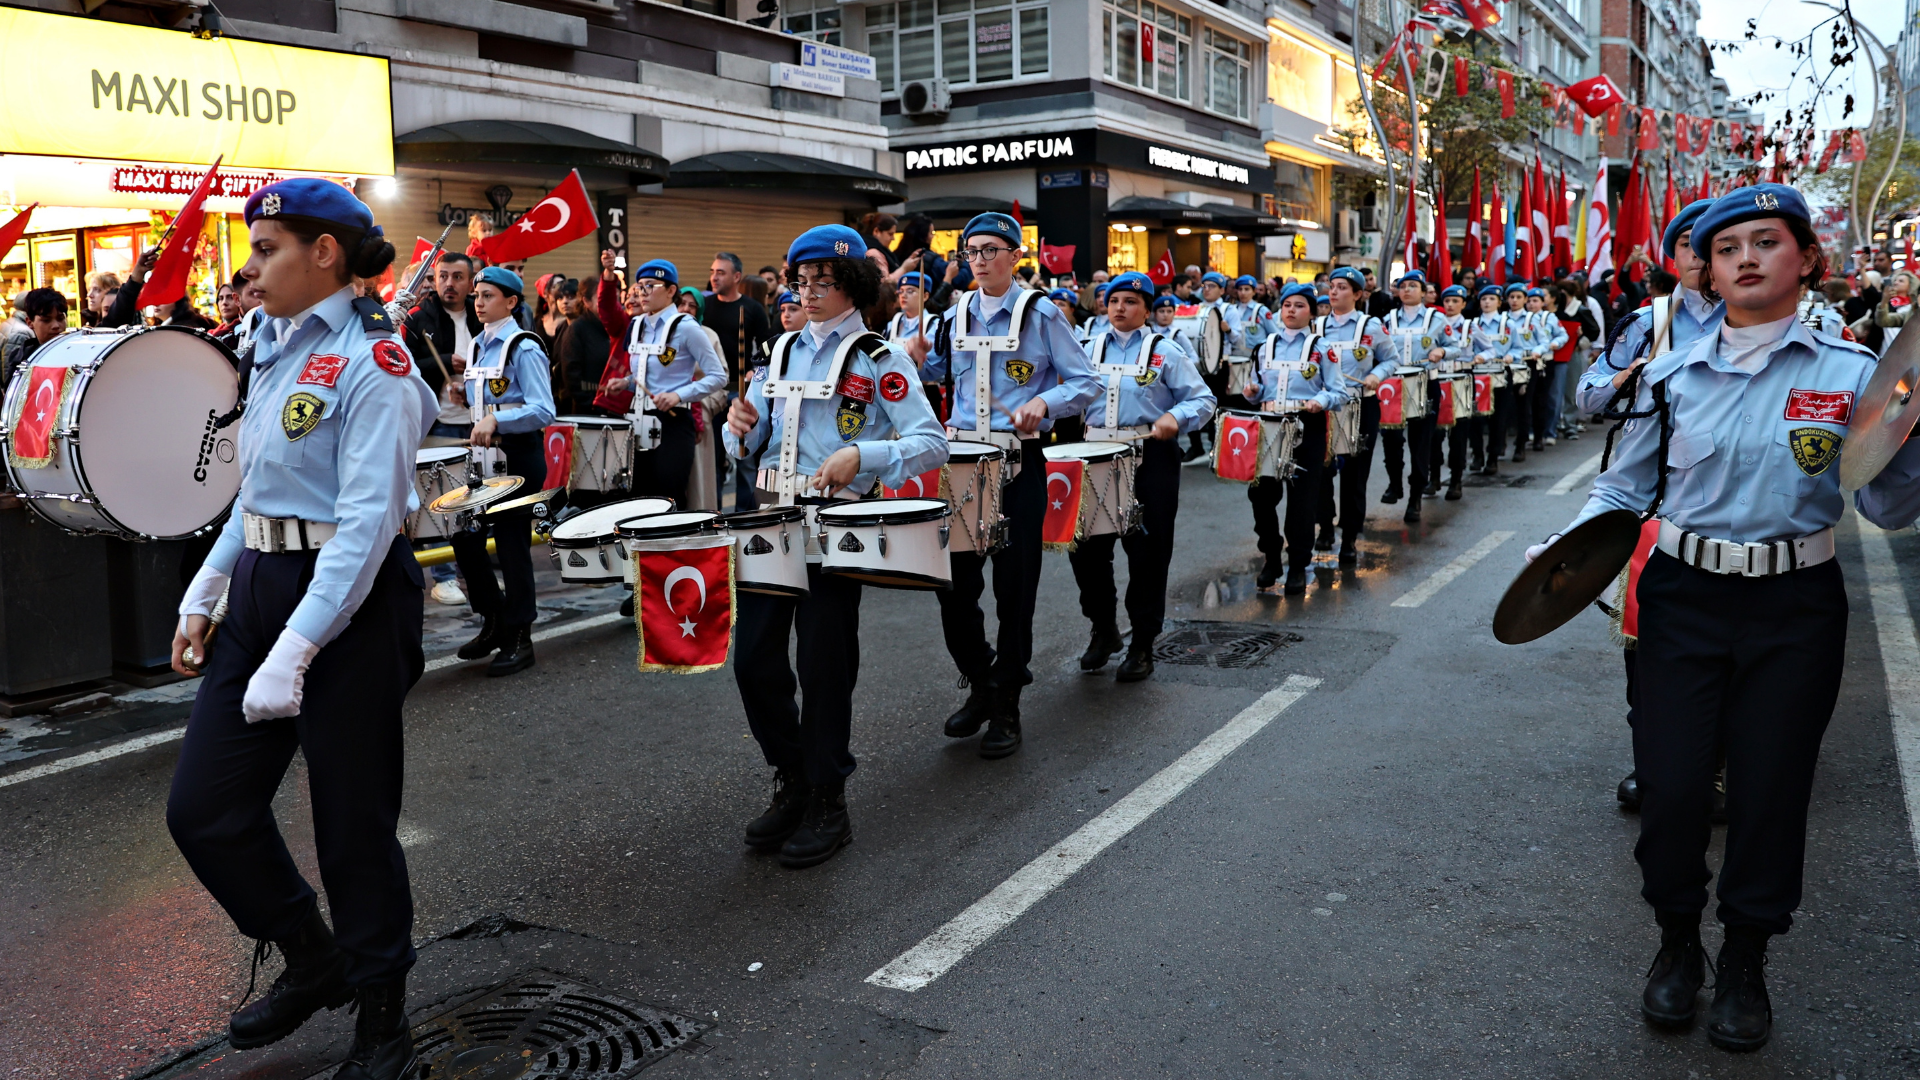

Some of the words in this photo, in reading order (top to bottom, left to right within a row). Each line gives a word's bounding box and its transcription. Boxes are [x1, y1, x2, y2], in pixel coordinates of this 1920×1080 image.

[821, 48, 839, 58] MALİ
[840, 51, 871, 65] MÜŞAVİR
[91, 69, 189, 117] MAXI
[202, 82, 296, 125] SHOP
[906, 145, 978, 170] PATRIC
[982, 136, 1074, 164] PARFUM
[118, 171, 165, 190] MAXI
[1792, 440, 1810, 468] SAMSUN
